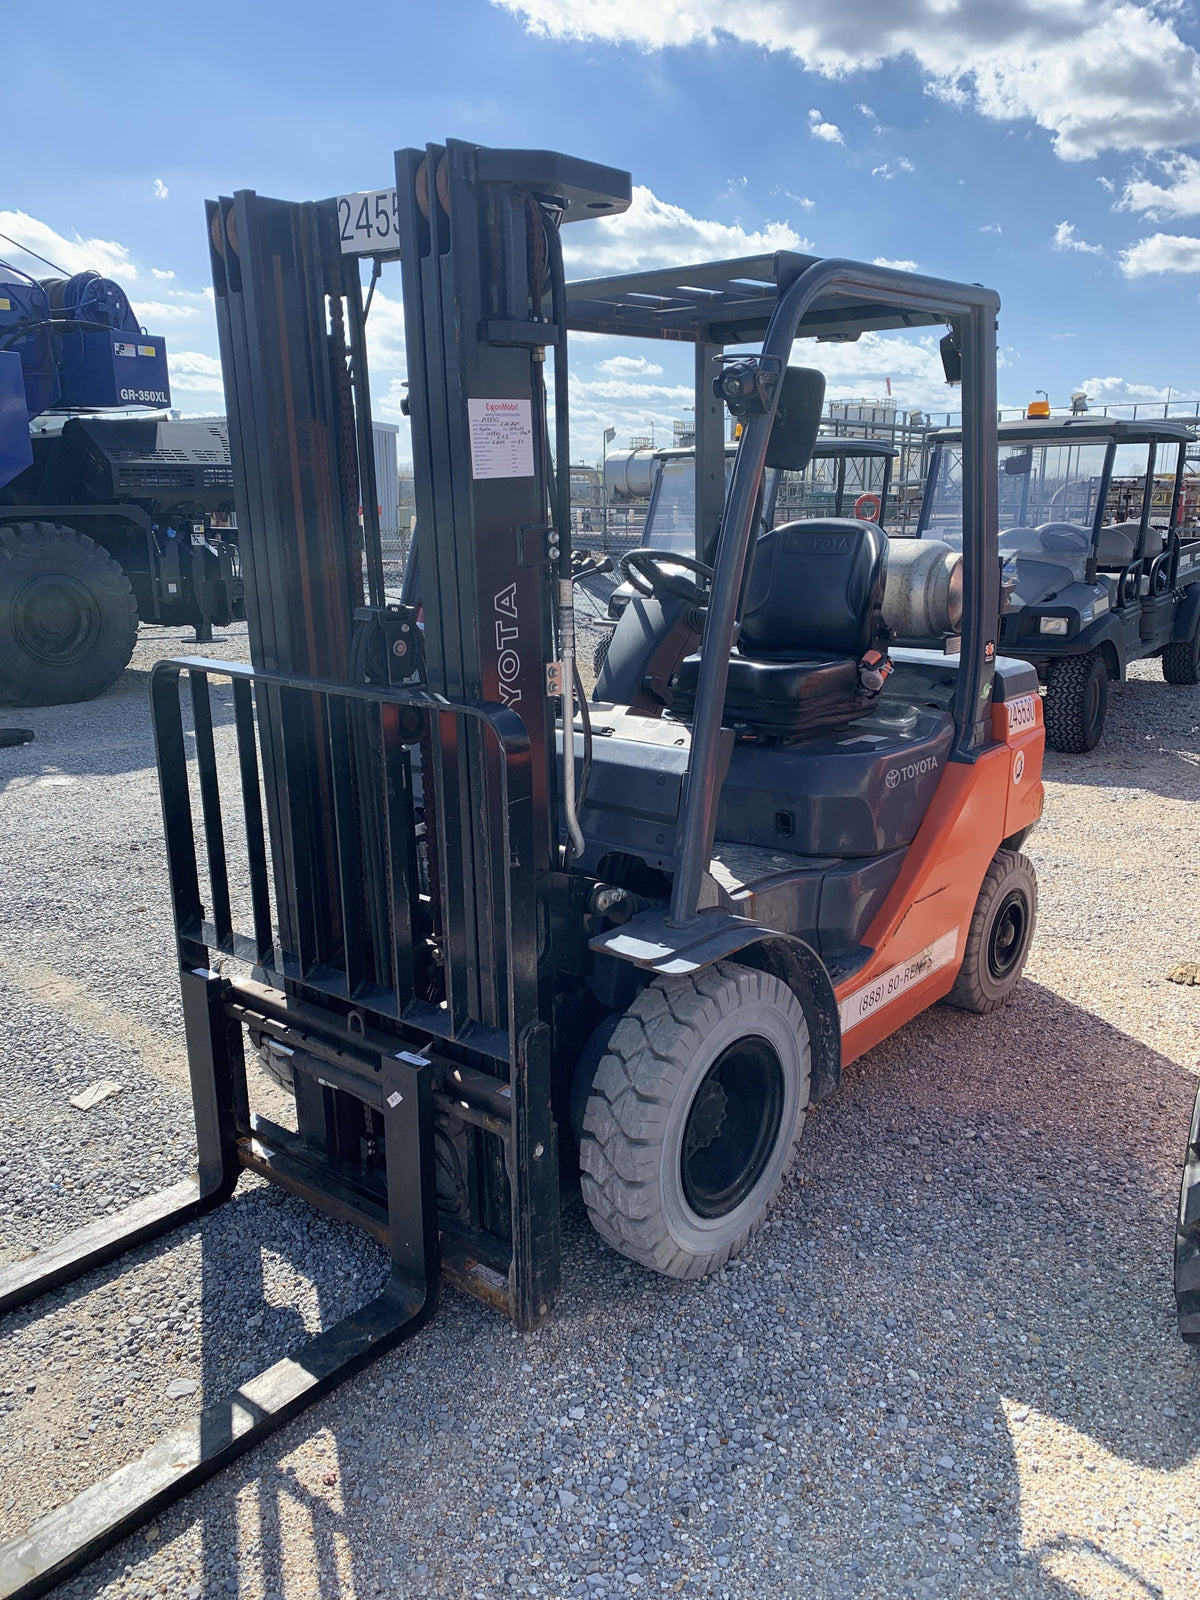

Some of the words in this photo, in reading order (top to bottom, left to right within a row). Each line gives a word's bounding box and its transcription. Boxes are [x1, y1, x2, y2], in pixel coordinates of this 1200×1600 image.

[120, 388, 168, 403] GR-350XL
[485, 403, 518, 412] ExxonMobil
[494, 582, 522, 708] YOTA
[1006, 697, 1035, 729] 245530
[901, 755, 938, 781] TOYOTA
[858, 984, 885, 1015] (888)
